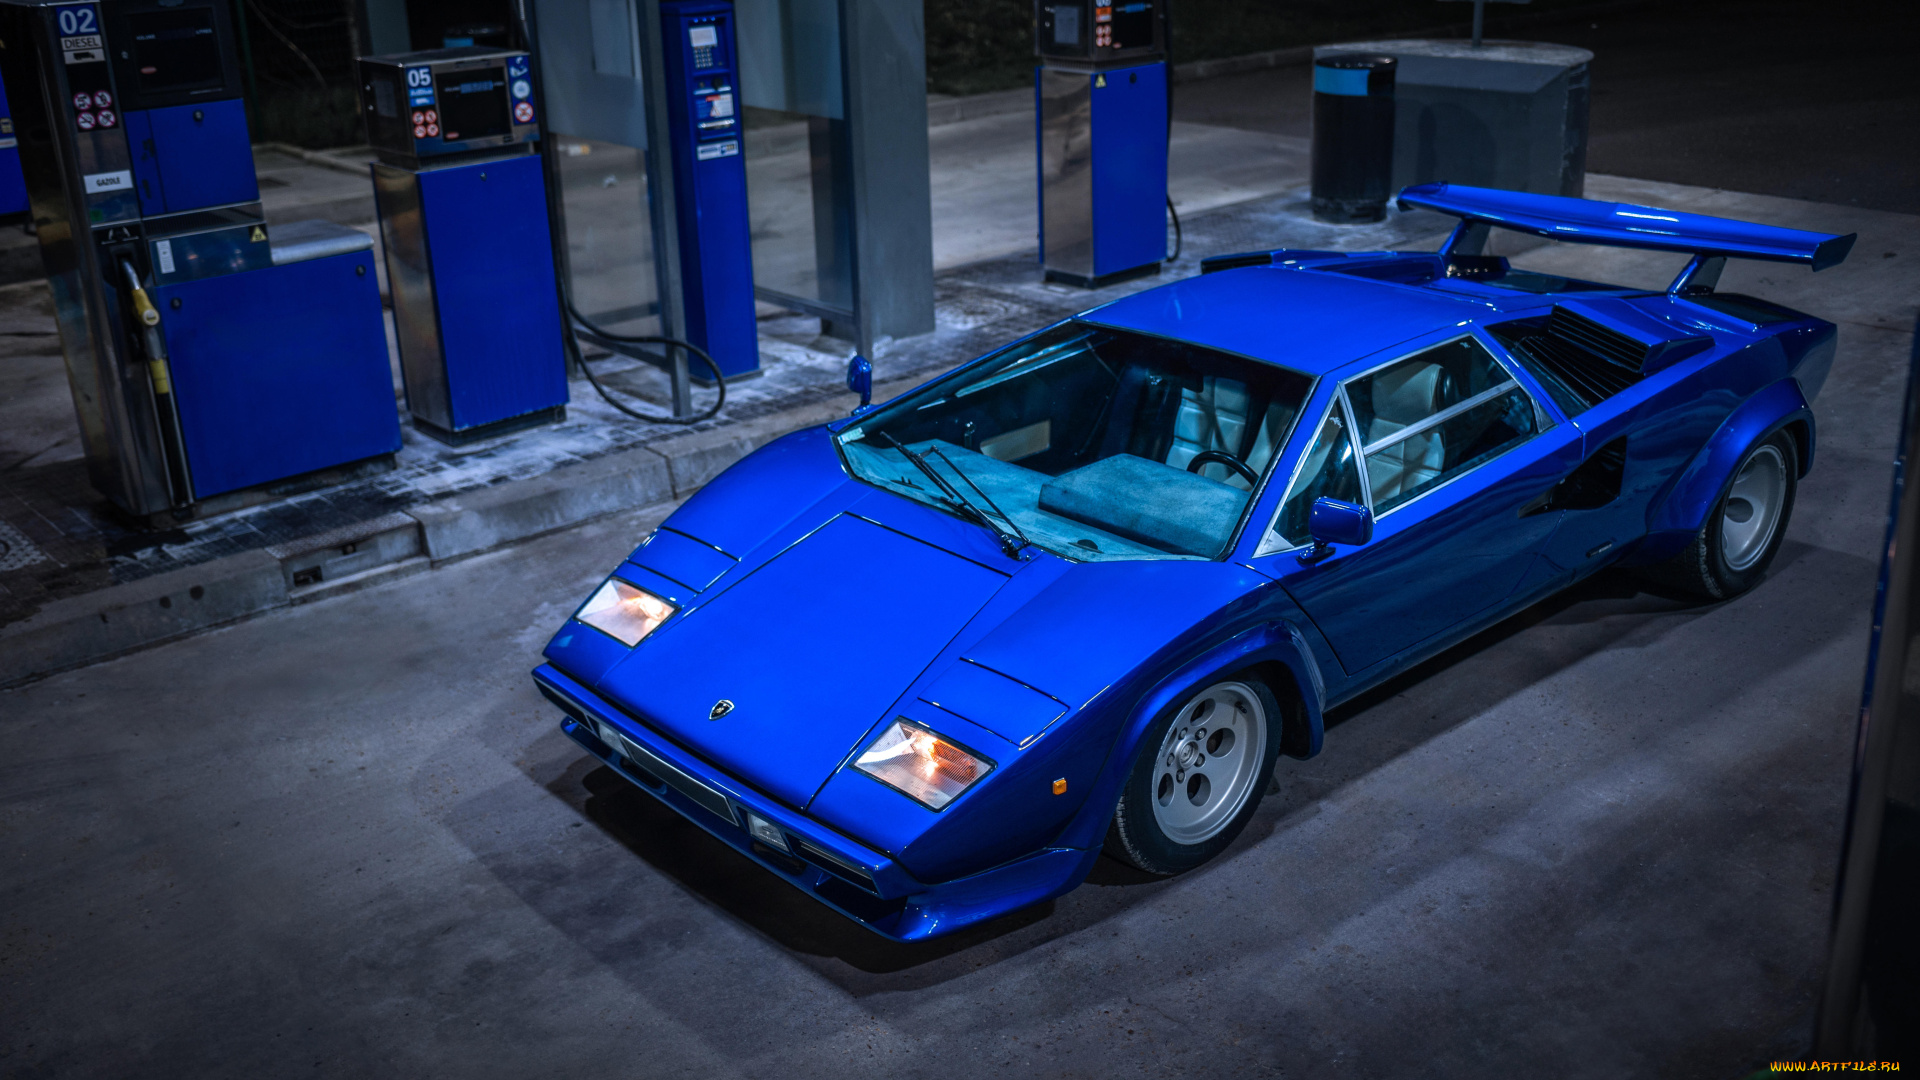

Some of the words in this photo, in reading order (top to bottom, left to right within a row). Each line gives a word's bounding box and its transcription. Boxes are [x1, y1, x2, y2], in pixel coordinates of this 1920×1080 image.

[60, 9, 97, 34] 02
[64, 38, 100, 48] DIESEL
[409, 68, 431, 87] 05
[96, 176, 121, 187] GAZOLE
